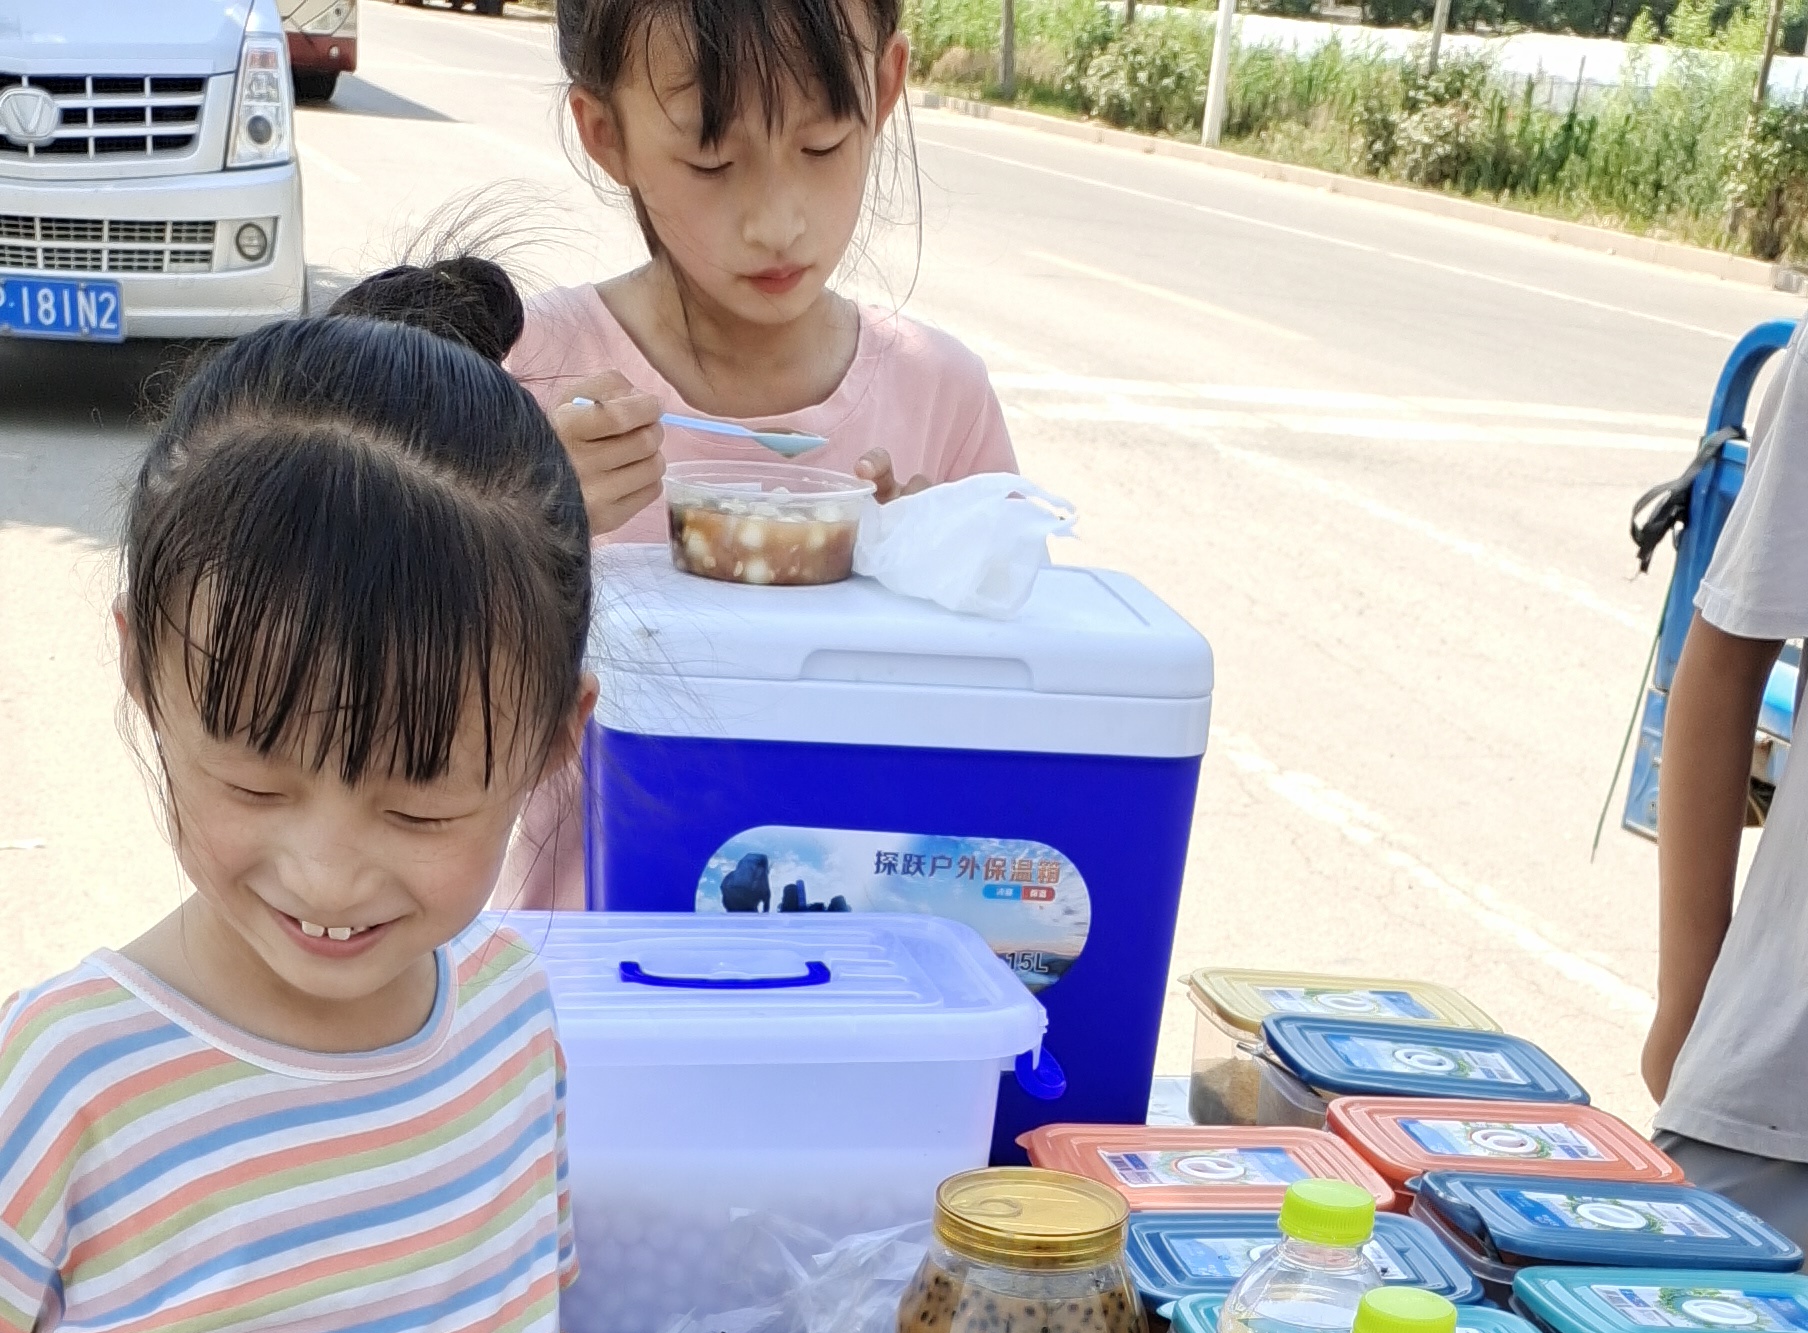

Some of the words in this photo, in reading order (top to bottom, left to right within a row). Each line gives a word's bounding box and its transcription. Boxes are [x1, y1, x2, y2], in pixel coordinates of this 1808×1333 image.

[873, 850, 1062, 885] 探跃户外保温箱
[1006, 951, 1049, 973] 15L
